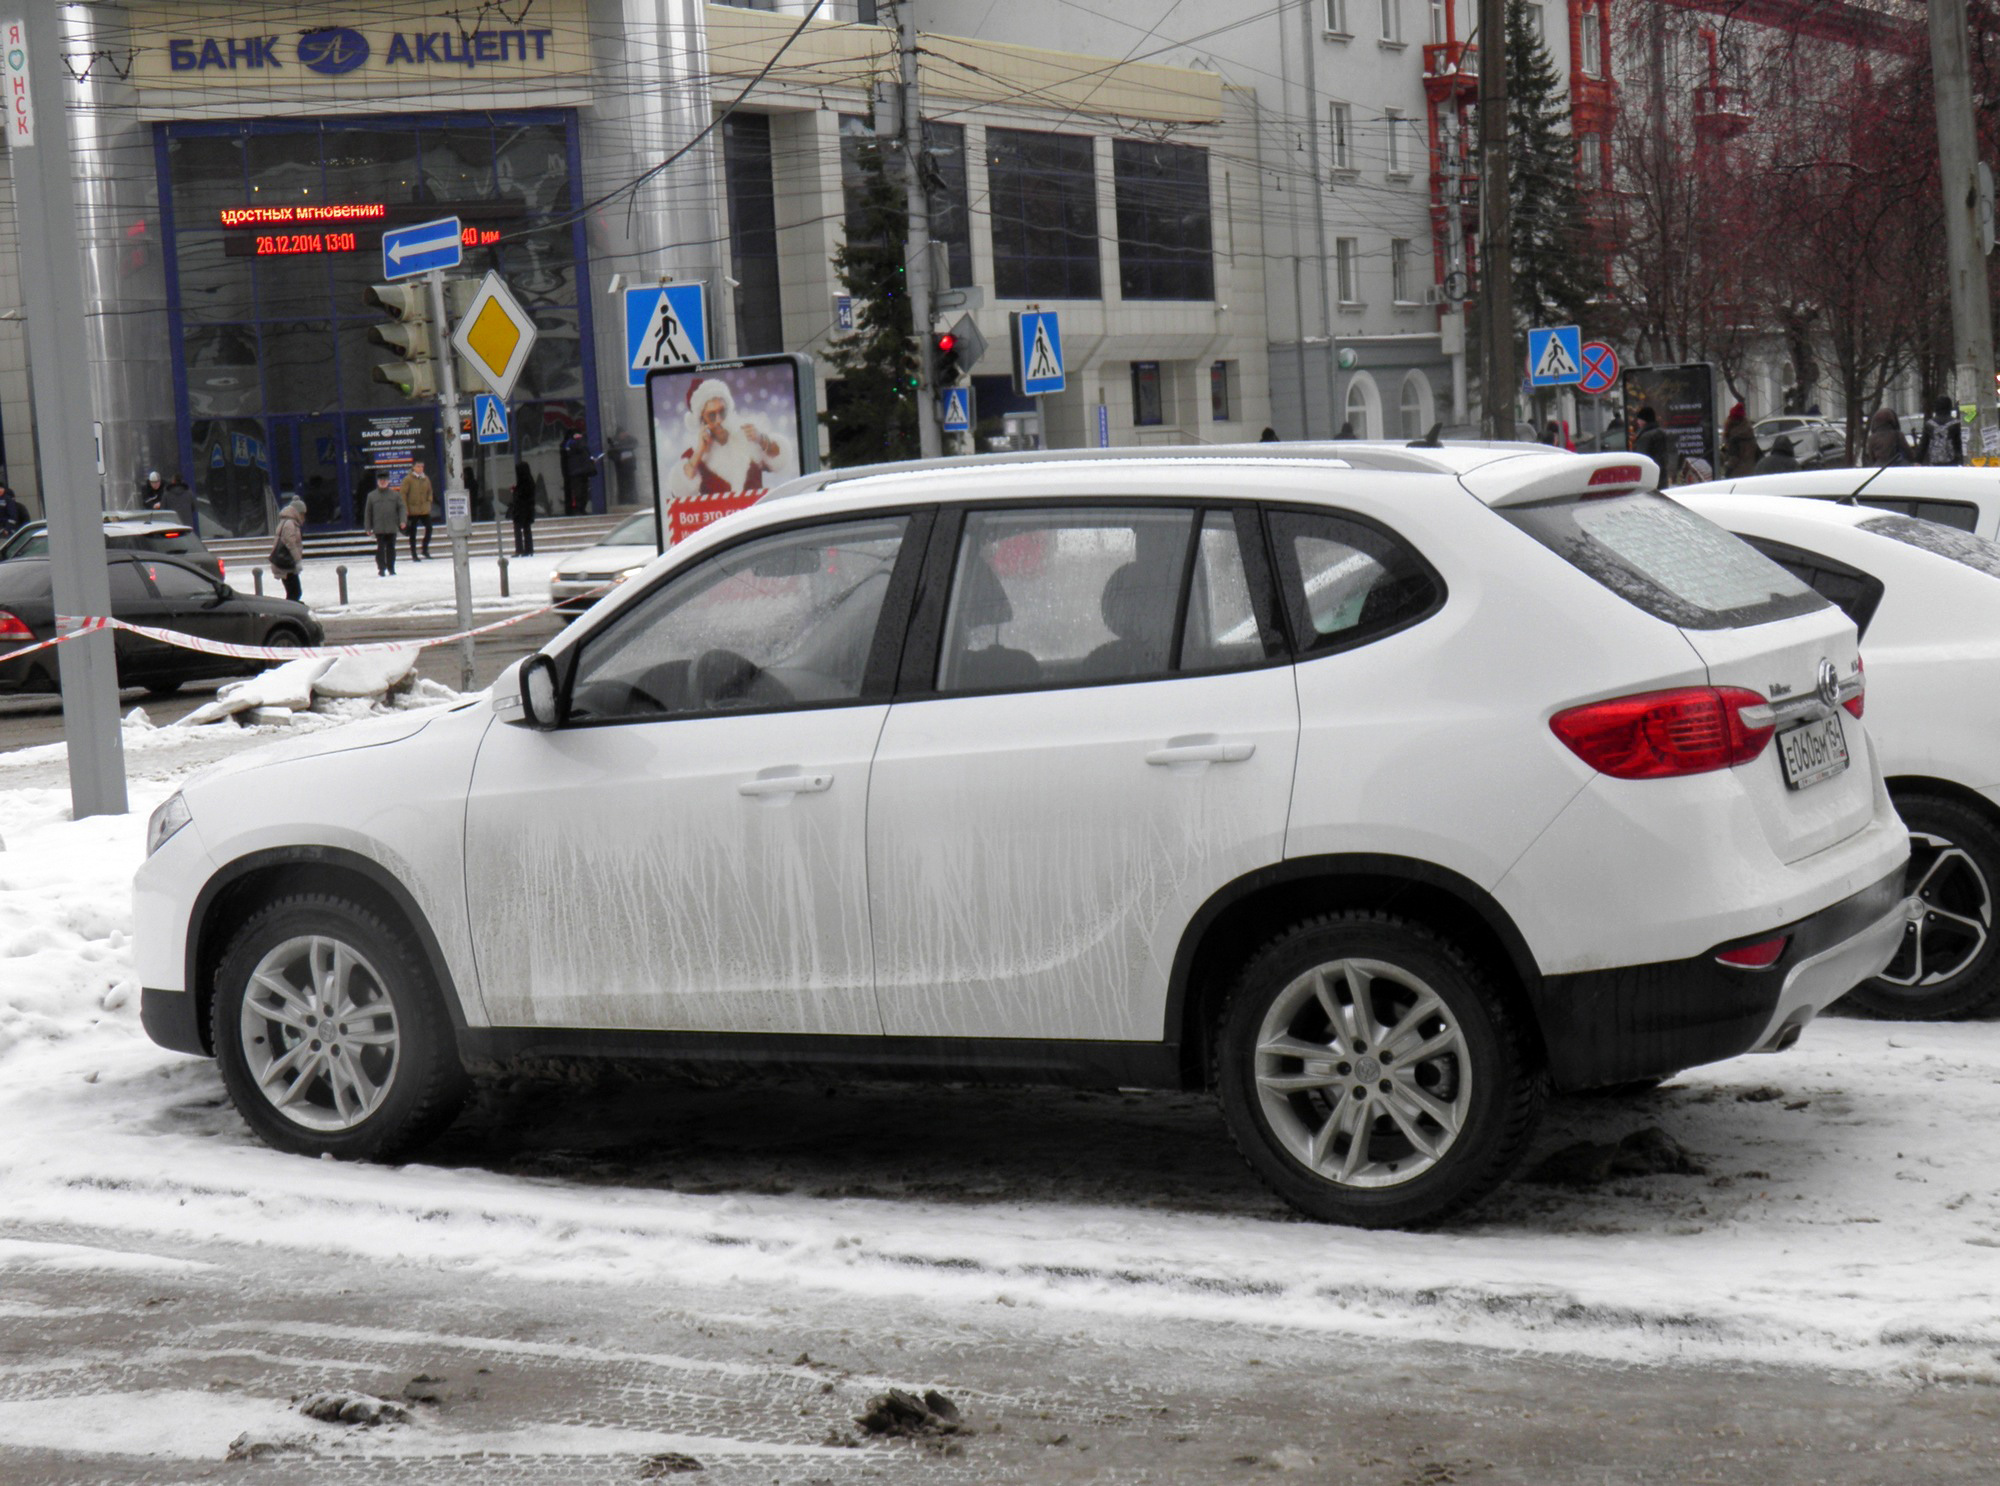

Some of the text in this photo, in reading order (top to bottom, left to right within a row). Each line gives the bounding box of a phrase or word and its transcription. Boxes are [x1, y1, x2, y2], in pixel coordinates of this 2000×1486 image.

[8, 25, 20, 45] Я
[169, 28, 553, 72] БАНК АКЦЕПТ
[256, 232, 355, 255] 26.12.2014 13:01
[839, 307, 851, 325] 14
[361, 427, 422, 438] БАНК АКЦЕПТ
[679, 512, 700, 524] Вот
[702, 509, 723, 522] это
[1785, 731, 1830, 776] Е060ВМ
